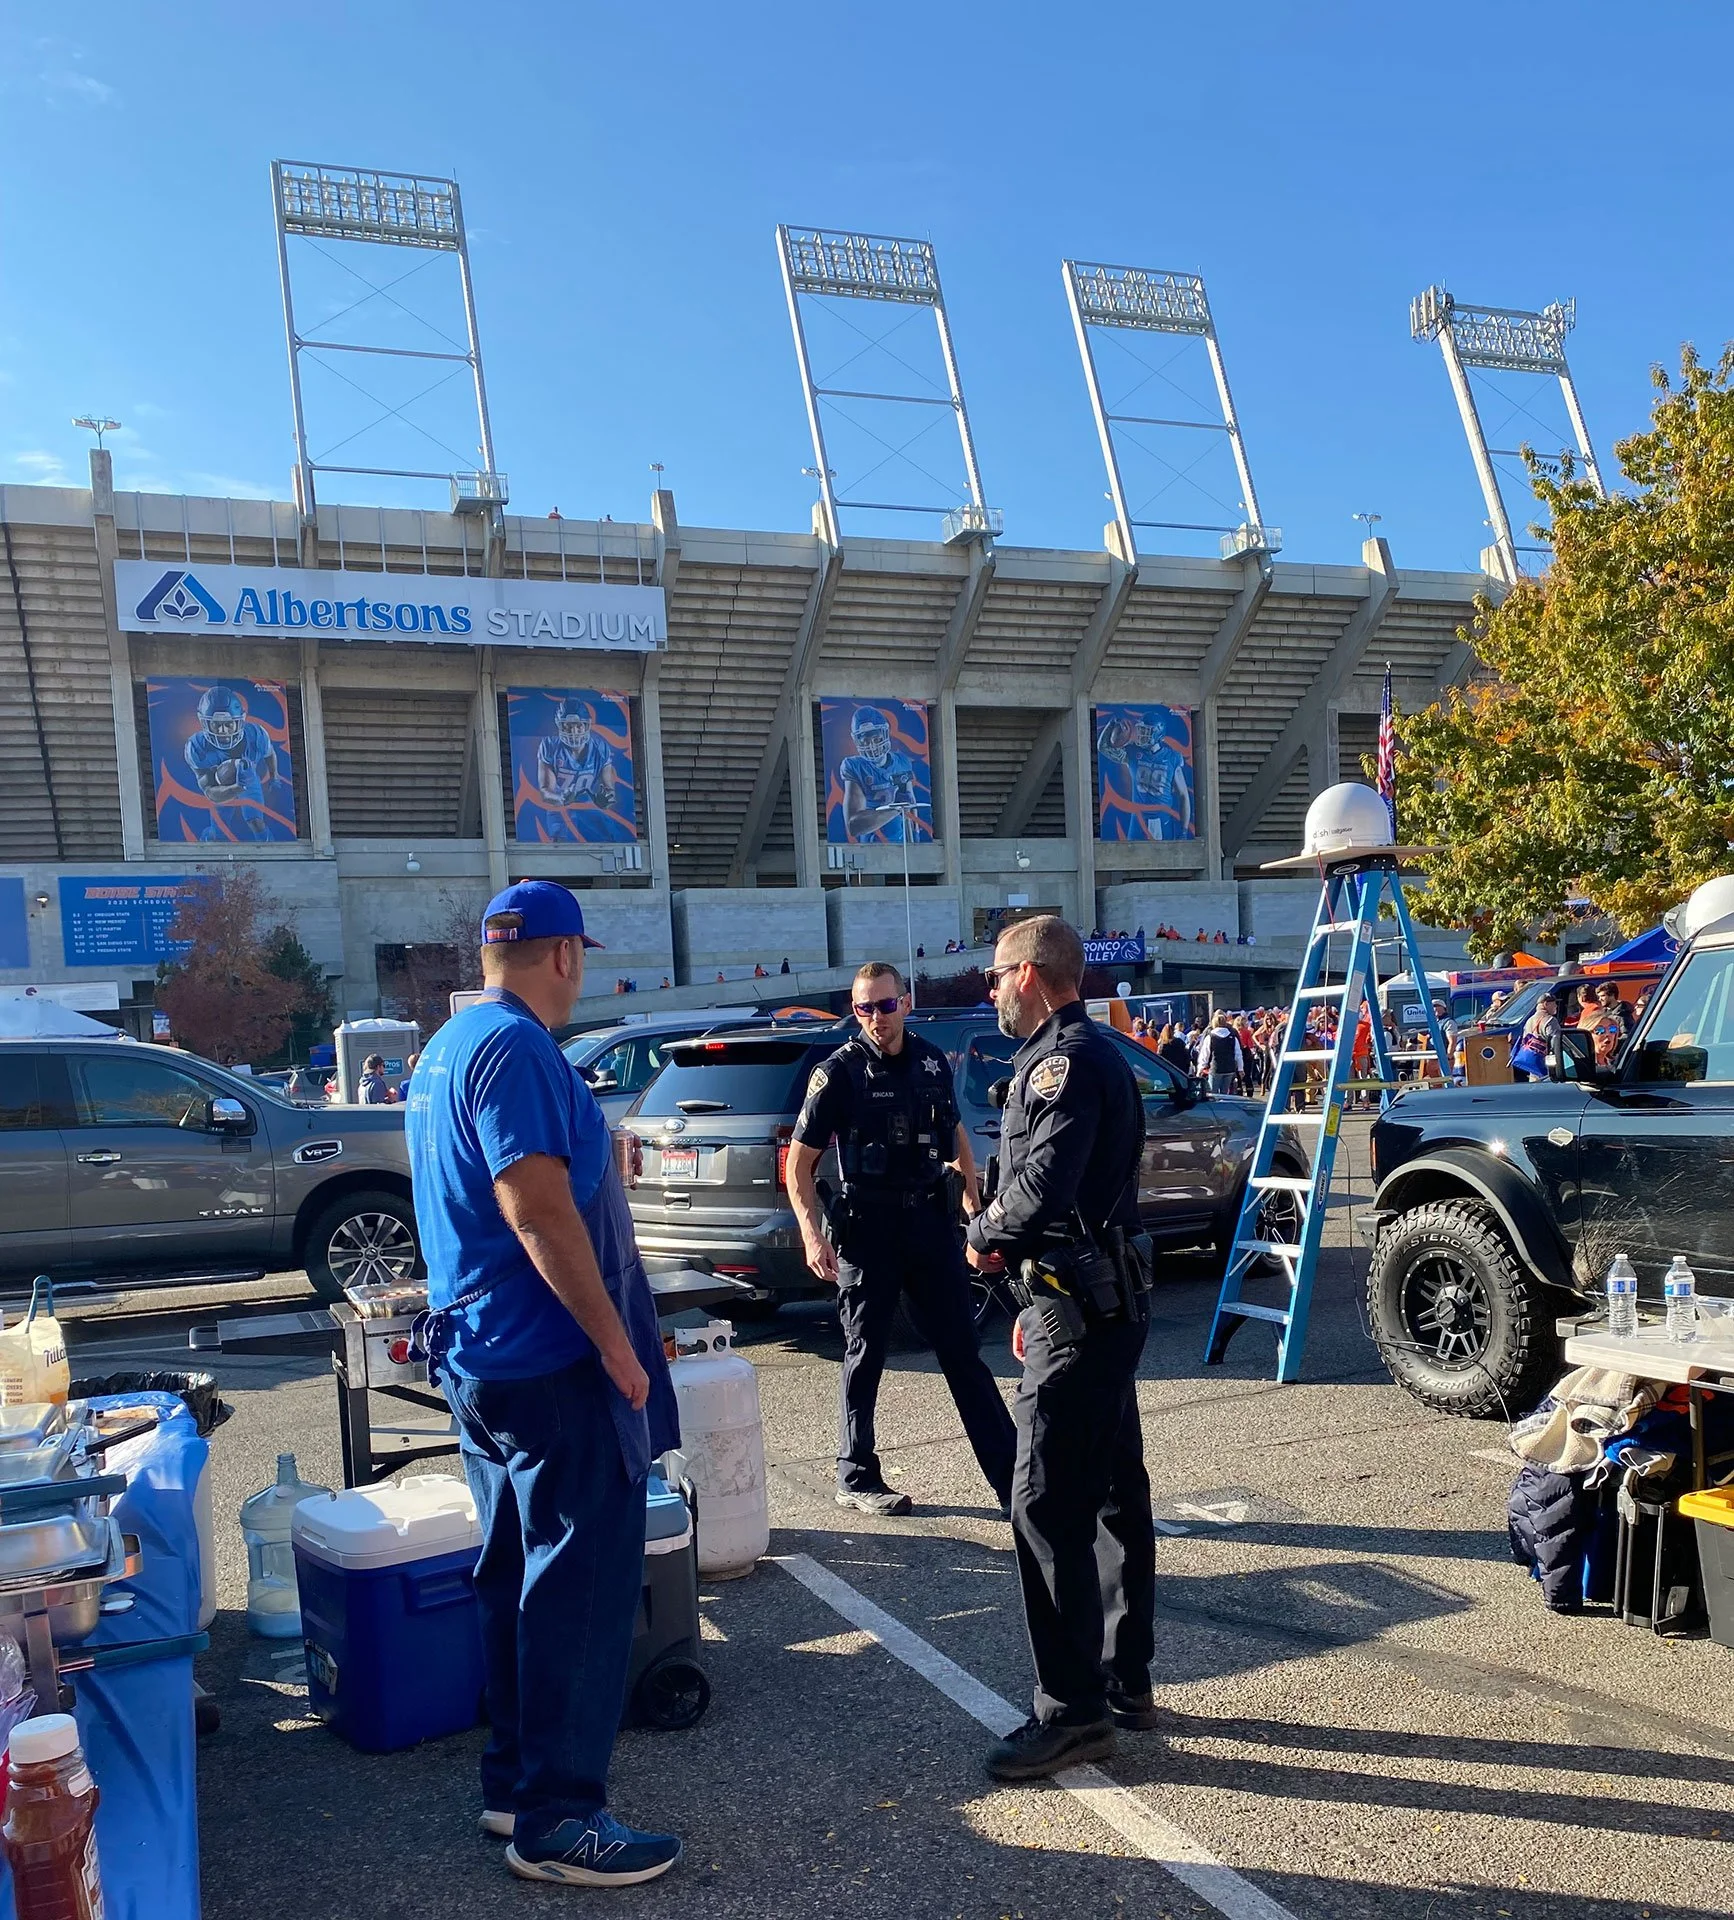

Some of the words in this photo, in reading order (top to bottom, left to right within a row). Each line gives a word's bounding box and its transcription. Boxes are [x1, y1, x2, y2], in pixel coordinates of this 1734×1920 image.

[232, 586, 472, 635] Albertsons
[487, 607, 655, 642] STADIUM
[1313, 829, 1329, 839] dish
[1083, 941, 1120, 952] RONCO
[1084, 951, 1117, 962] ALLEY
[305, 1149, 323, 1157] V8
[198, 1206, 264, 1217] TITAN
